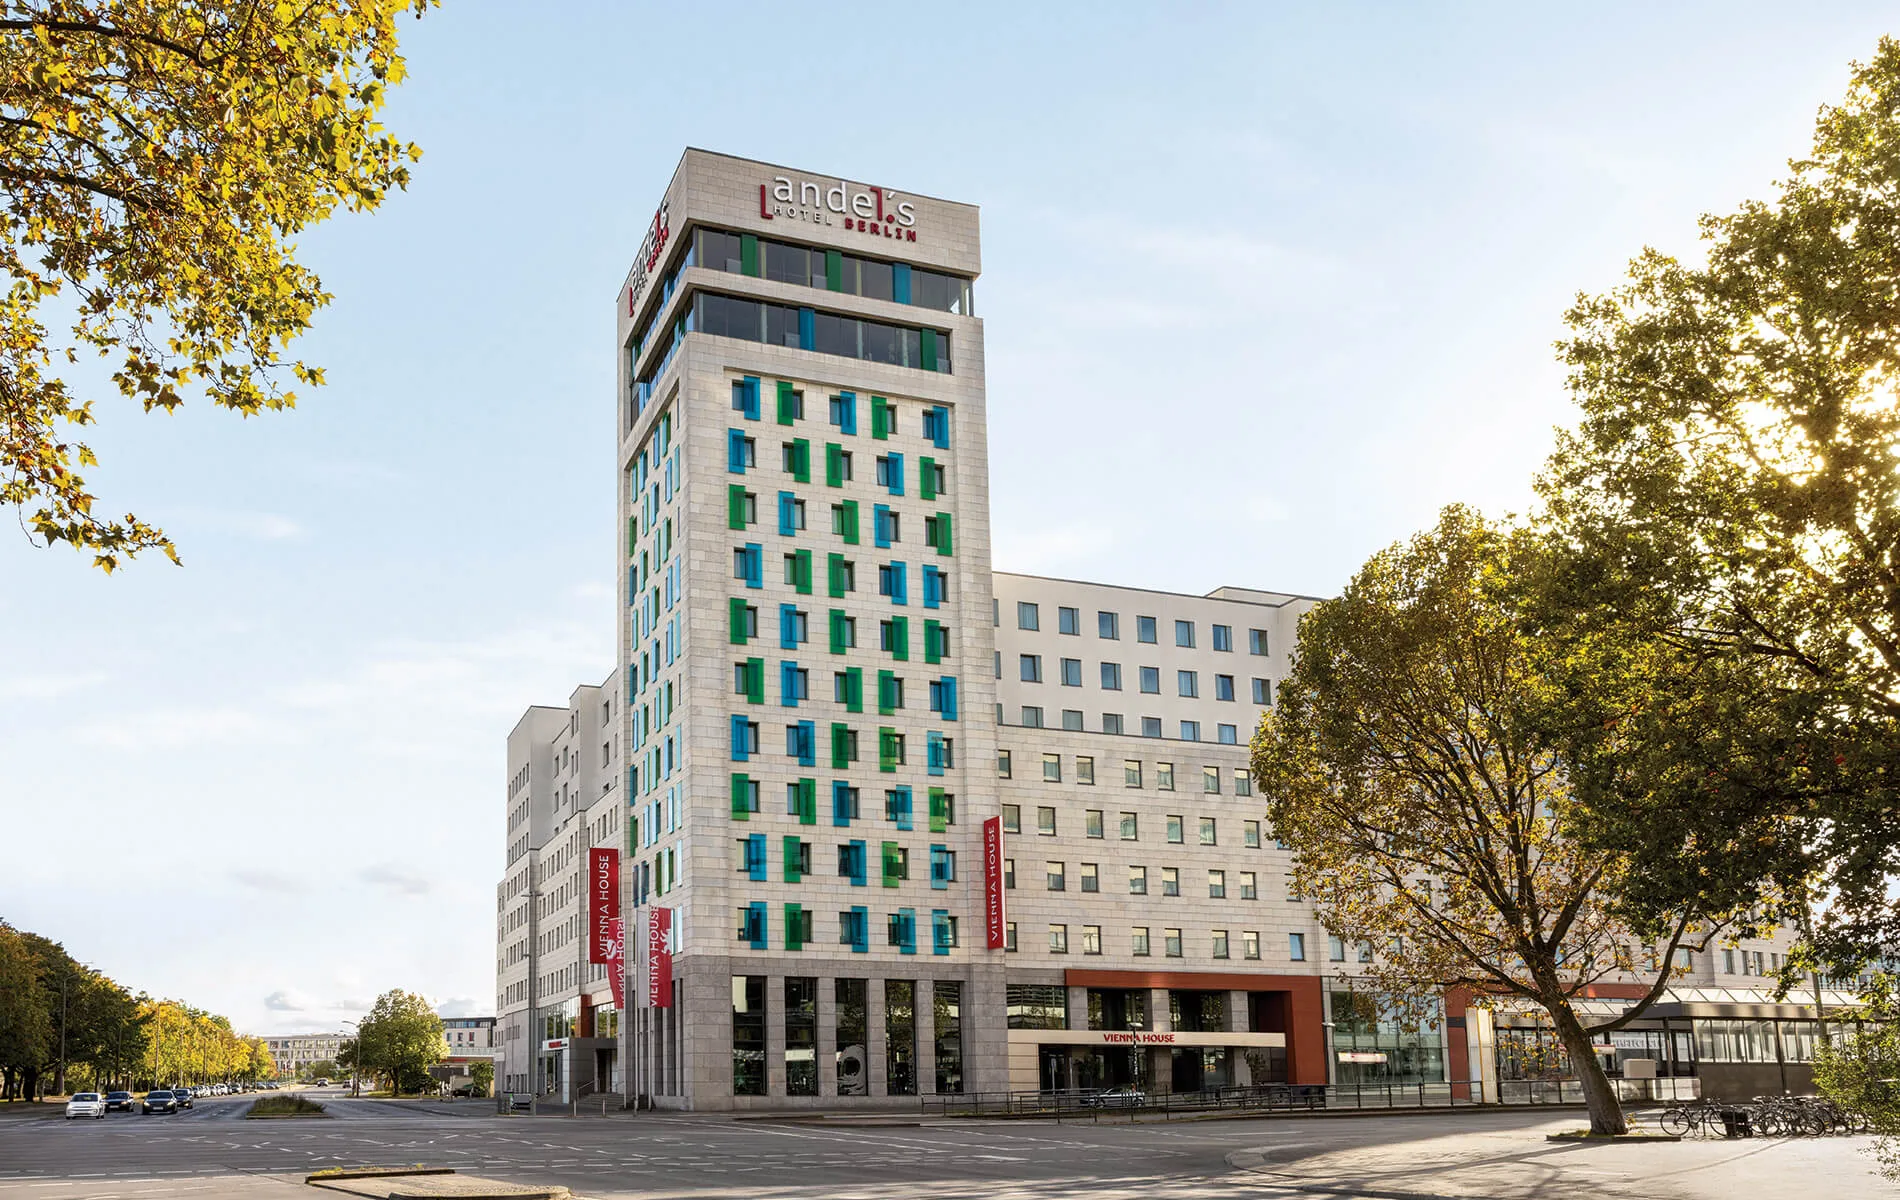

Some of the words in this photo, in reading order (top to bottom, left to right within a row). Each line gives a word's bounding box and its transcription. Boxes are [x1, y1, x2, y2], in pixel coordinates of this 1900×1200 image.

[773, 203, 833, 226] HOTEL
[844, 216, 917, 242] BERLIN
[988, 825, 996, 877] HOUSE
[599, 855, 609, 900] HOUSE
[599, 904, 609, 957] VIENNA
[649, 904, 659, 951] HOUSE
[989, 881, 998, 941] VIENNA
[649, 955, 659, 1007] VIENNA
[1103, 1033, 1141, 1043] VIENNA
[1142, 1034, 1175, 1043] HOUSE
